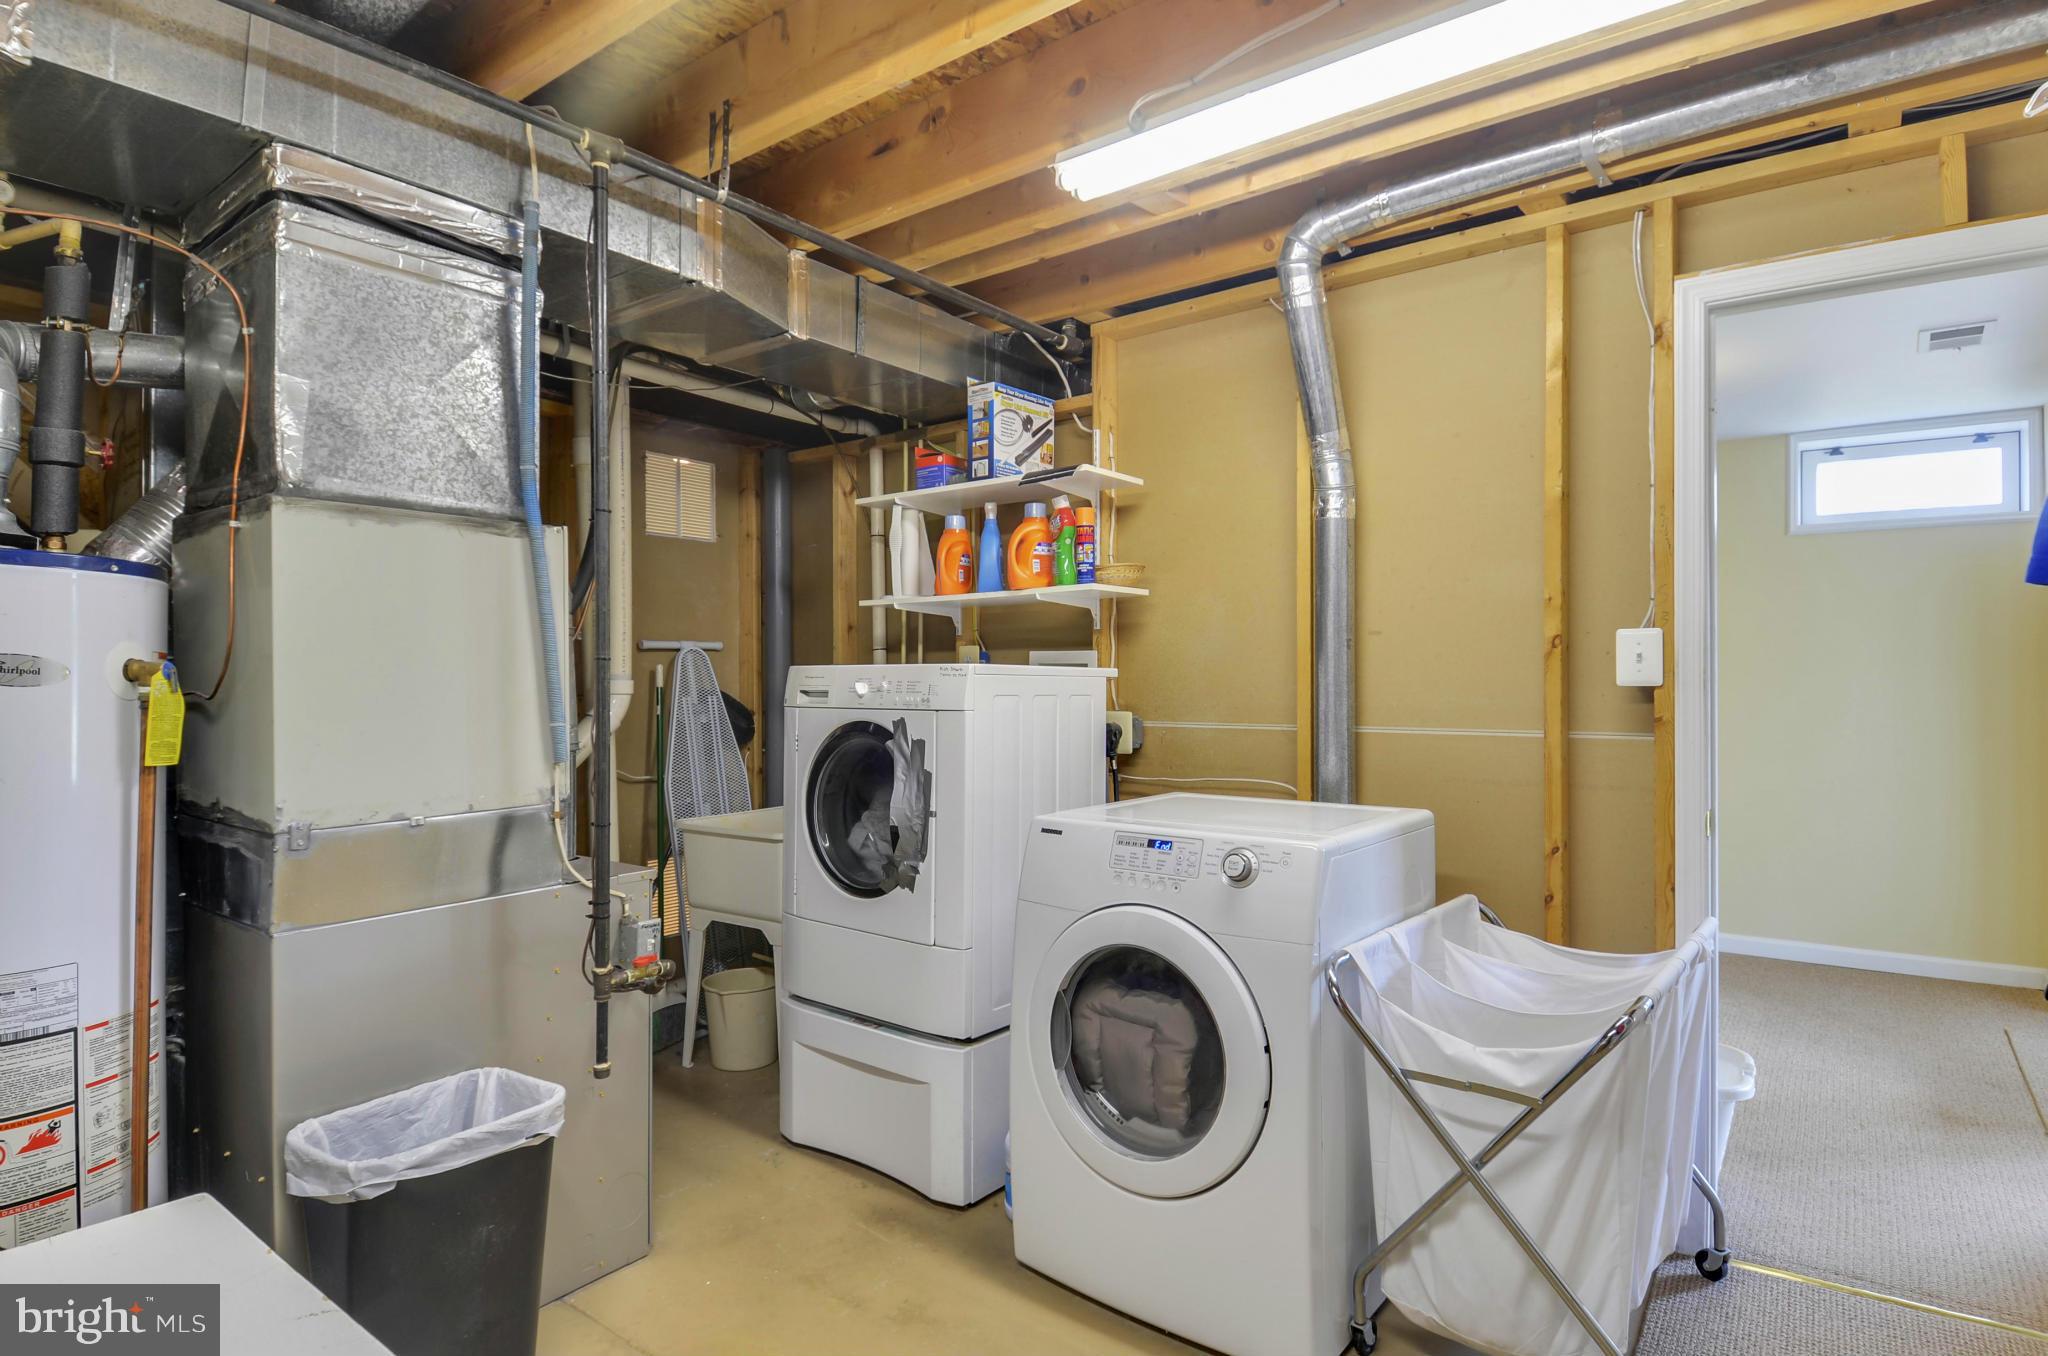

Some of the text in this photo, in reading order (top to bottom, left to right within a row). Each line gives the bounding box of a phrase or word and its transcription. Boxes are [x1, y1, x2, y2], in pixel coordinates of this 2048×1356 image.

[1077, 527, 1094, 535] TATIC
[0, 665, 40, 676] hirlpool
[1154, 840, 1171, 851] End
[0, 1117, 39, 1130] ARNING
[2, 1202, 40, 1216] DANGER
